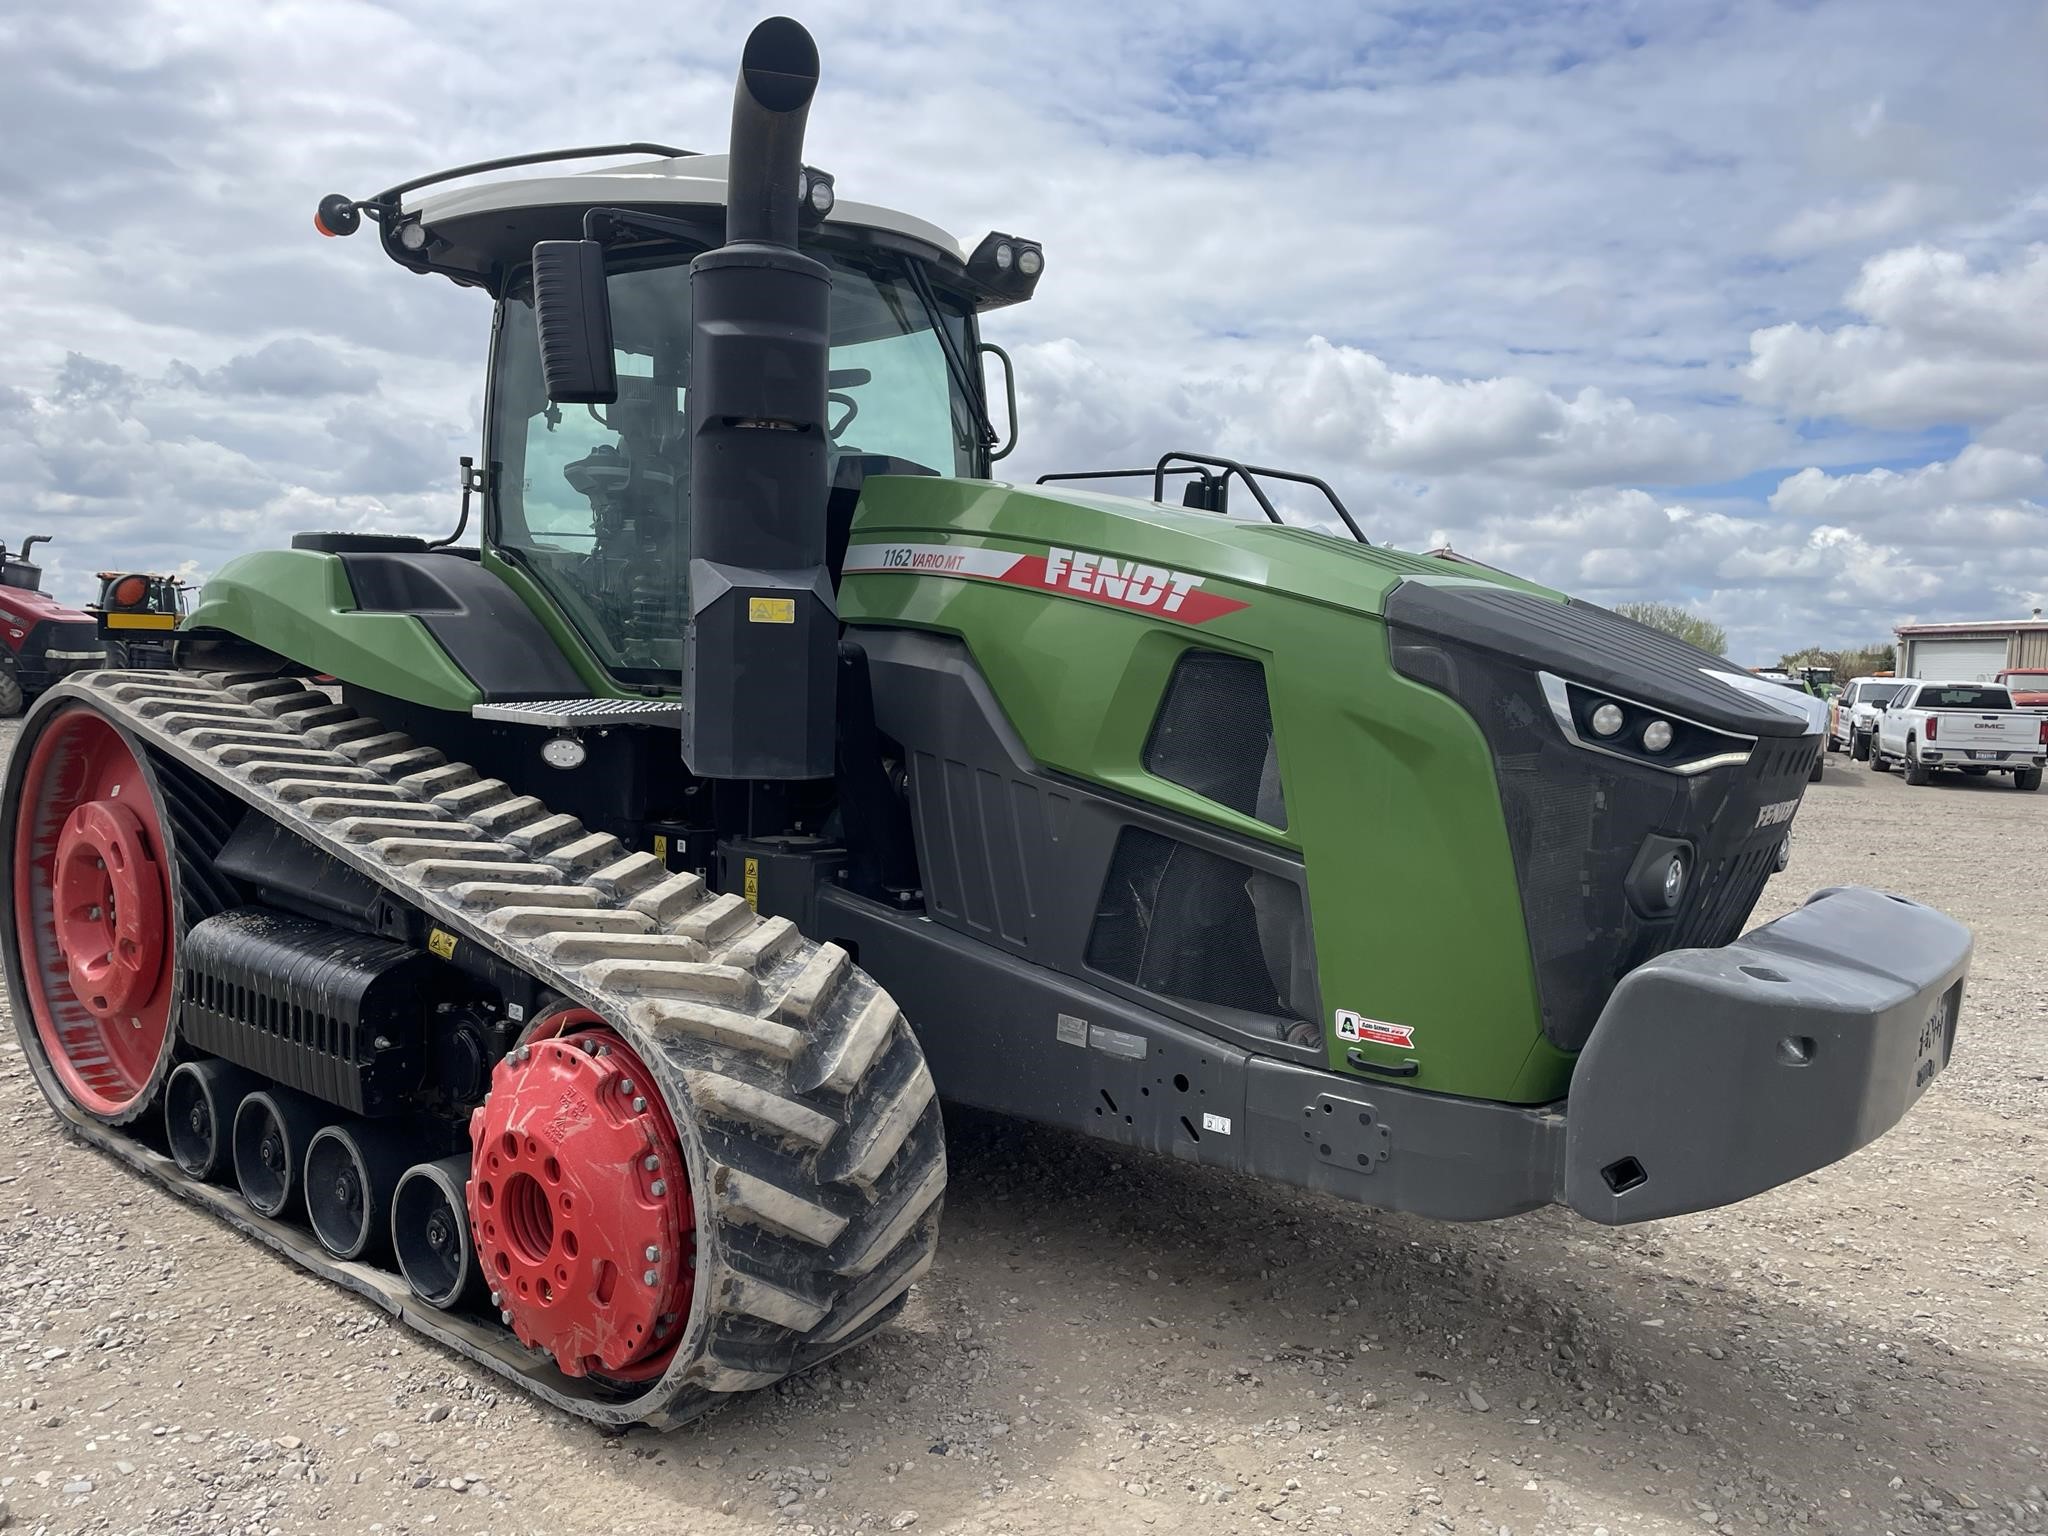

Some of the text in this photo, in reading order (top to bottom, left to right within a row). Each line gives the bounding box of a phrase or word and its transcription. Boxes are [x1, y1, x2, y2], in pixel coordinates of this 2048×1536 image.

[883, 549, 965, 570] 1162 VARIO MT
[1044, 546, 1206, 612] FENDT
[1755, 799, 1799, 829] FENDT
